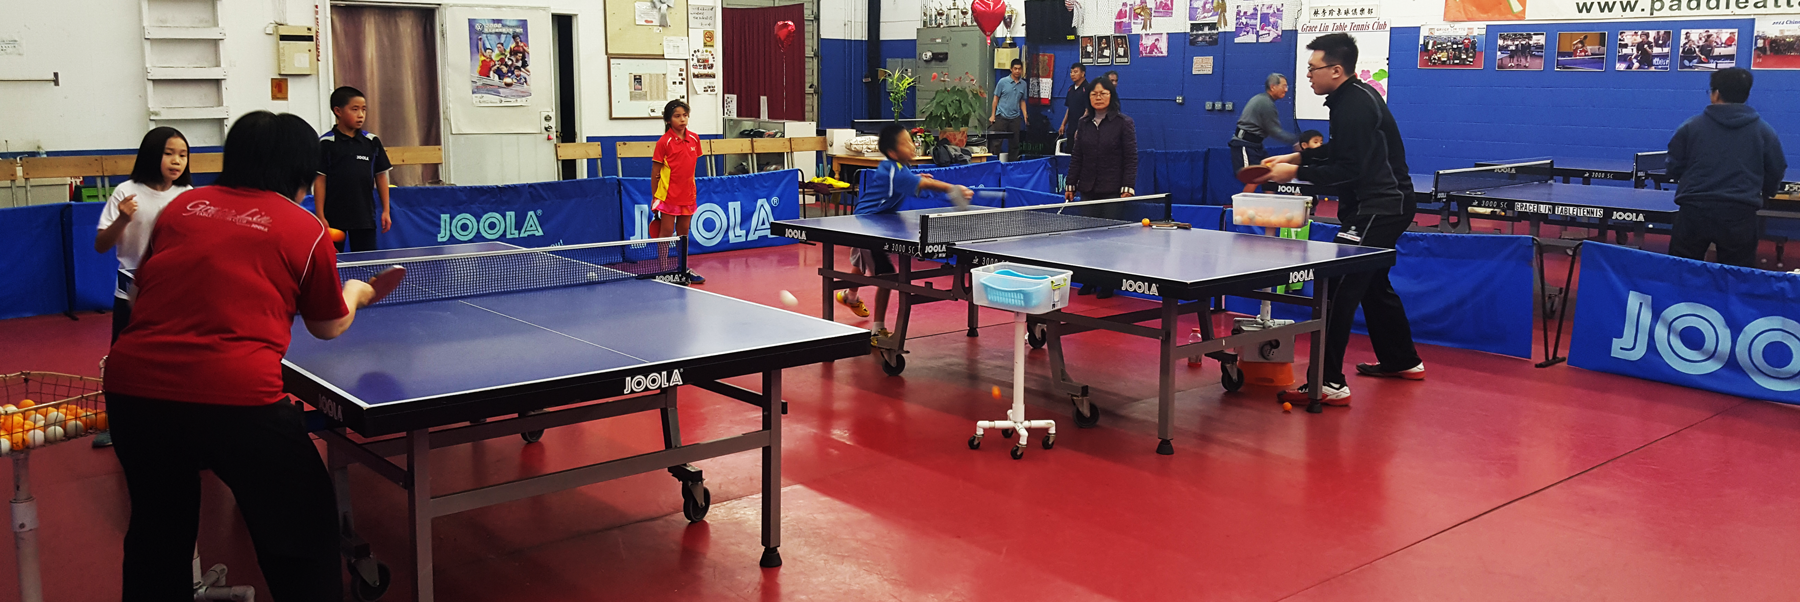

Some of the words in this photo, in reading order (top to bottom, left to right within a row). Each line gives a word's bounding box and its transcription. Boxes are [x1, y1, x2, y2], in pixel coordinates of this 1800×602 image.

[1301, 23, 1318, 32] Grace
[1318, 22, 1330, 32] Lin
[1331, 22, 1348, 32] Table
[1349, 21, 1370, 31] Tennis
[1371, 21, 1388, 30] Club
[1278, 185, 1301, 193] JOOLA
[1515, 202, 1537, 213] GRACE
[1538, 204, 1553, 214] LIN
[1555, 205, 1577, 217] TABLE
[1578, 207, 1604, 218] TENNIS
[1612, 211, 1645, 222] JOOLA
[437, 210, 544, 242] JOOLA
[785, 228, 807, 240] JOOLA
[892, 243, 906, 252] 3000
[925, 244, 947, 254] JOOLA
[1289, 269, 1314, 284] JOOLA
[1121, 278, 1159, 296] JOOLA
[624, 369, 683, 395] JOOLA
[318, 393, 344, 422] JOOLA
